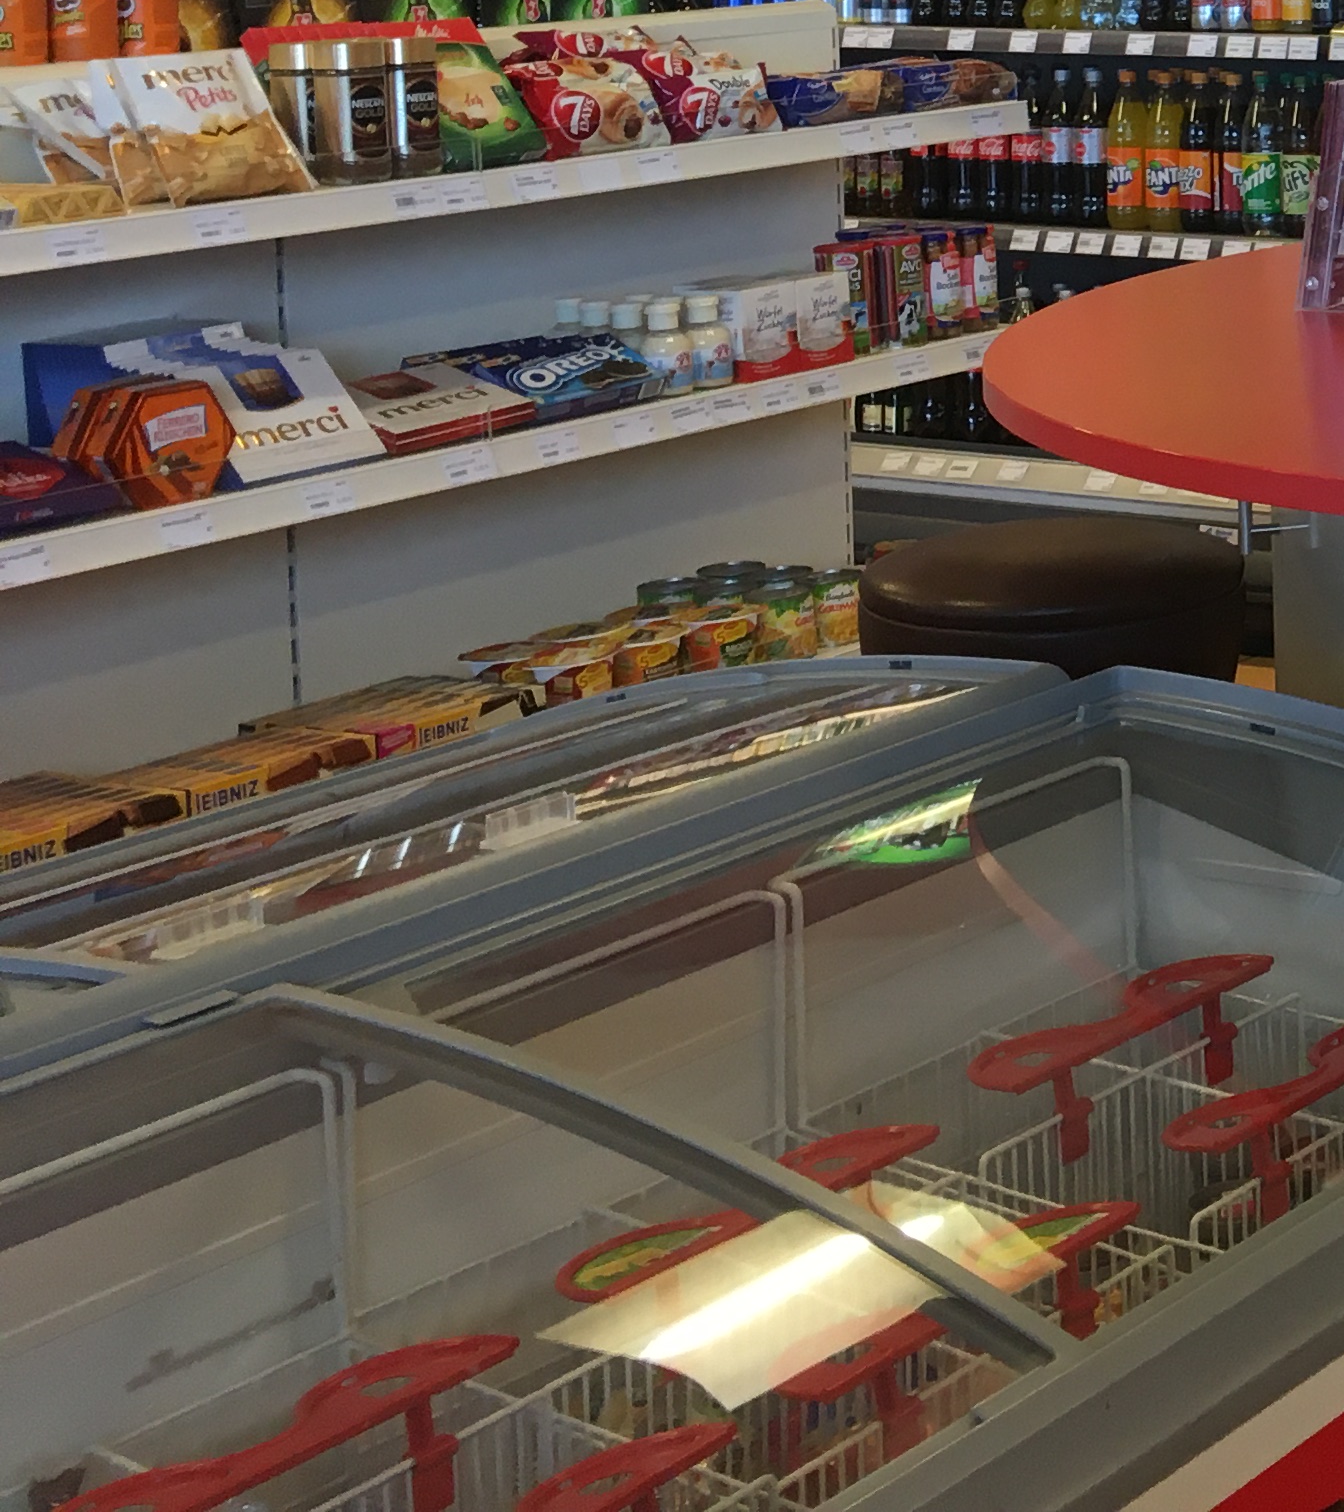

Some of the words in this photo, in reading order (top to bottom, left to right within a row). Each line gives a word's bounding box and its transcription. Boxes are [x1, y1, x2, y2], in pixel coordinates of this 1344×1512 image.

[177, 86, 238, 113] Petits
[355, 107, 385, 119] GOLD
[558, 94, 586, 136] 7
[578, 96, 596, 133] DAYS
[681, 91, 709, 130] 7
[703, 91, 719, 127] DAYS
[519, 347, 611, 389] OREO
[376, 384, 489, 420] merci
[235, 405, 350, 451] merci
[418, 715, 470, 746] LEIBNIZ
[195, 778, 260, 814] LEIBNIZ
